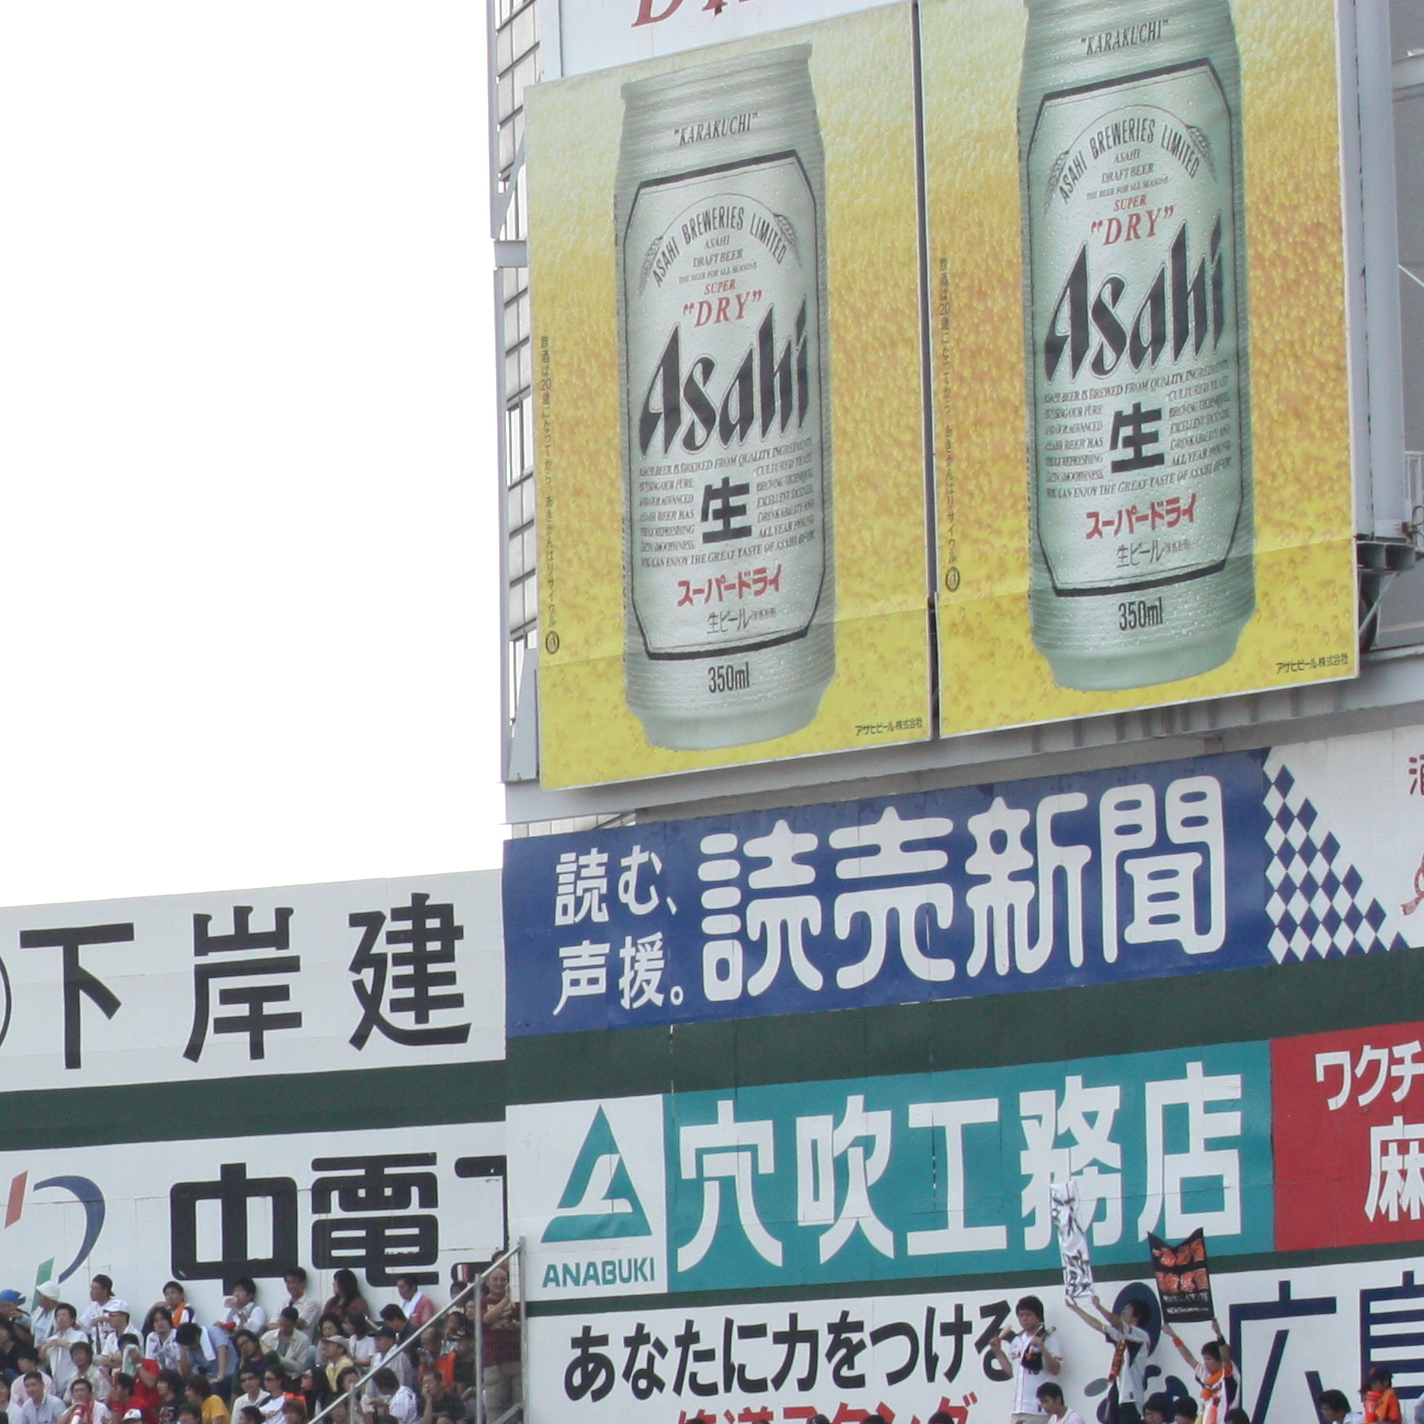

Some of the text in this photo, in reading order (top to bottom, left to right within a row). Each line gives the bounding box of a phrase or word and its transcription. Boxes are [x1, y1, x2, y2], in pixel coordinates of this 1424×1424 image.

[1058, 118, 1200, 204] ASAHI BREWERIES LIMITED
[1113, 194, 1147, 212] SUPER
[652, 206, 788, 288] ASAHI BREWERIES LIMITED
[703, 279, 737, 296] SUPER
[1044, 209, 1225, 385] Asahi
[638, 294, 810, 458] Asahi
[1109, 402, 1165, 473] 生
[701, 476, 752, 544] 生
[1086, 493, 1197, 540] スーパードライ
[676, 564, 782, 606] スーパードライ
[1118, 597, 1163, 631] 350ml
[708, 662, 750, 693] 350ml
[699, 774, 1228, 1003] 読売新聞
[19, 892, 472, 1070] 下岸建
[676, 1060, 1245, 1275] 穴吹工務店
[541, 1256, 657, 1289] ANABUKI
[563, 1299, 1014, 1402] あなたに力をつける
